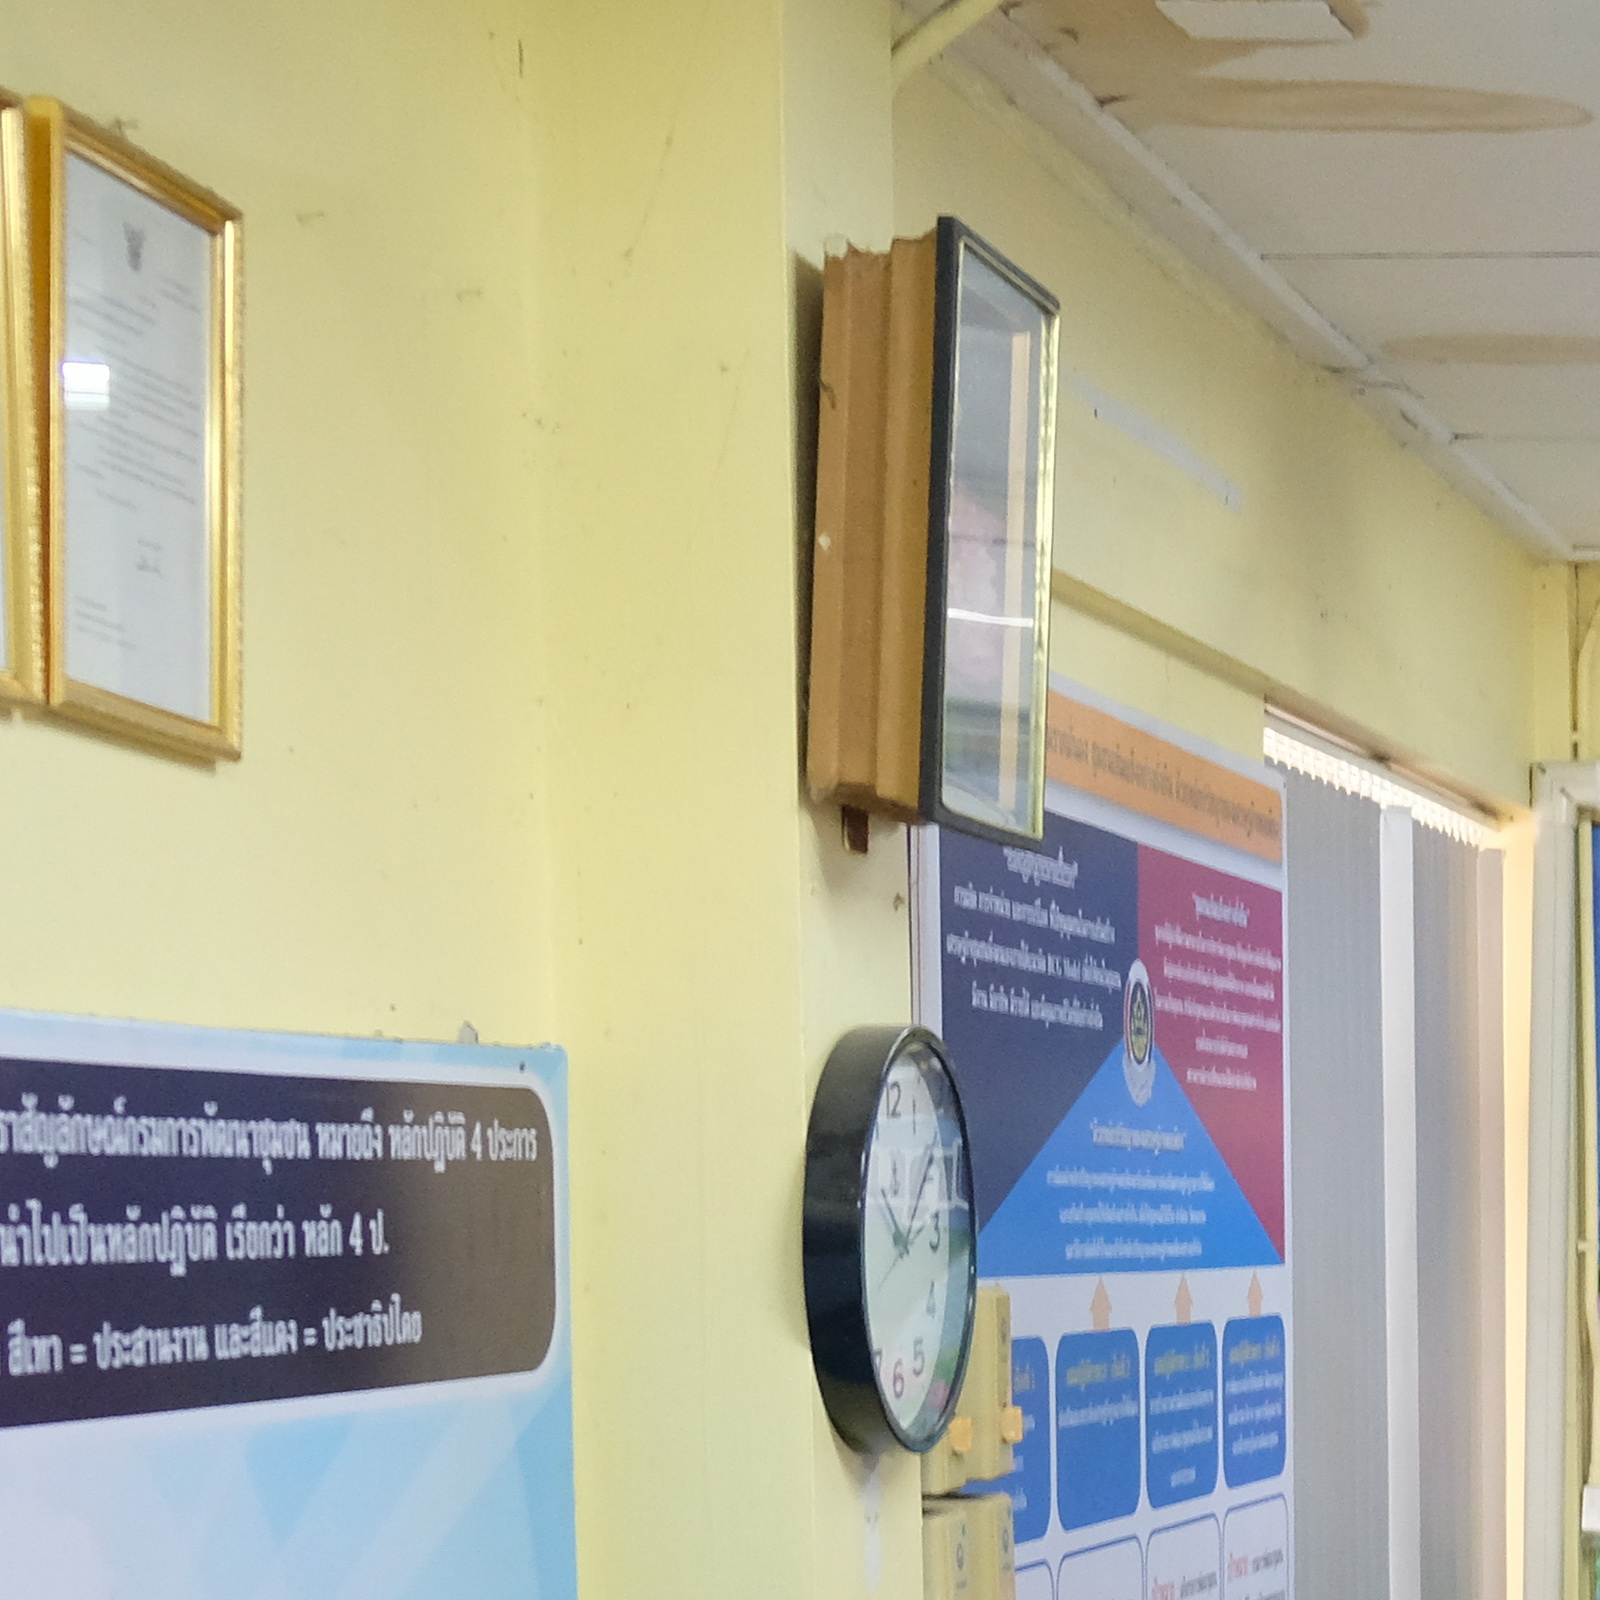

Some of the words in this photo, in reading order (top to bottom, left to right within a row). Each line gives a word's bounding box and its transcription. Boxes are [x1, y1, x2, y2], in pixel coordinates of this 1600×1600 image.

[316, 1107, 383, 1161] หมายถึง
[388, 1109, 467, 1173] หลักปฏิบัติ
[471, 1121, 483, 1161] 4
[487, 1117, 538, 1162] ประการ
[226, 1204, 296, 1260] เรียกว่า
[303, 1204, 343, 1259] หลัก
[349, 1212, 363, 1257] 4
[369, 1208, 390, 1254] ป.
[8, 1318, 63, 1376] สีเทา
[95, 1319, 210, 1371] ประสานงาน
[215, 1305, 298, 1361] และสีแดง
[323, 1293, 423, 1351] ประชาธิปไตย
